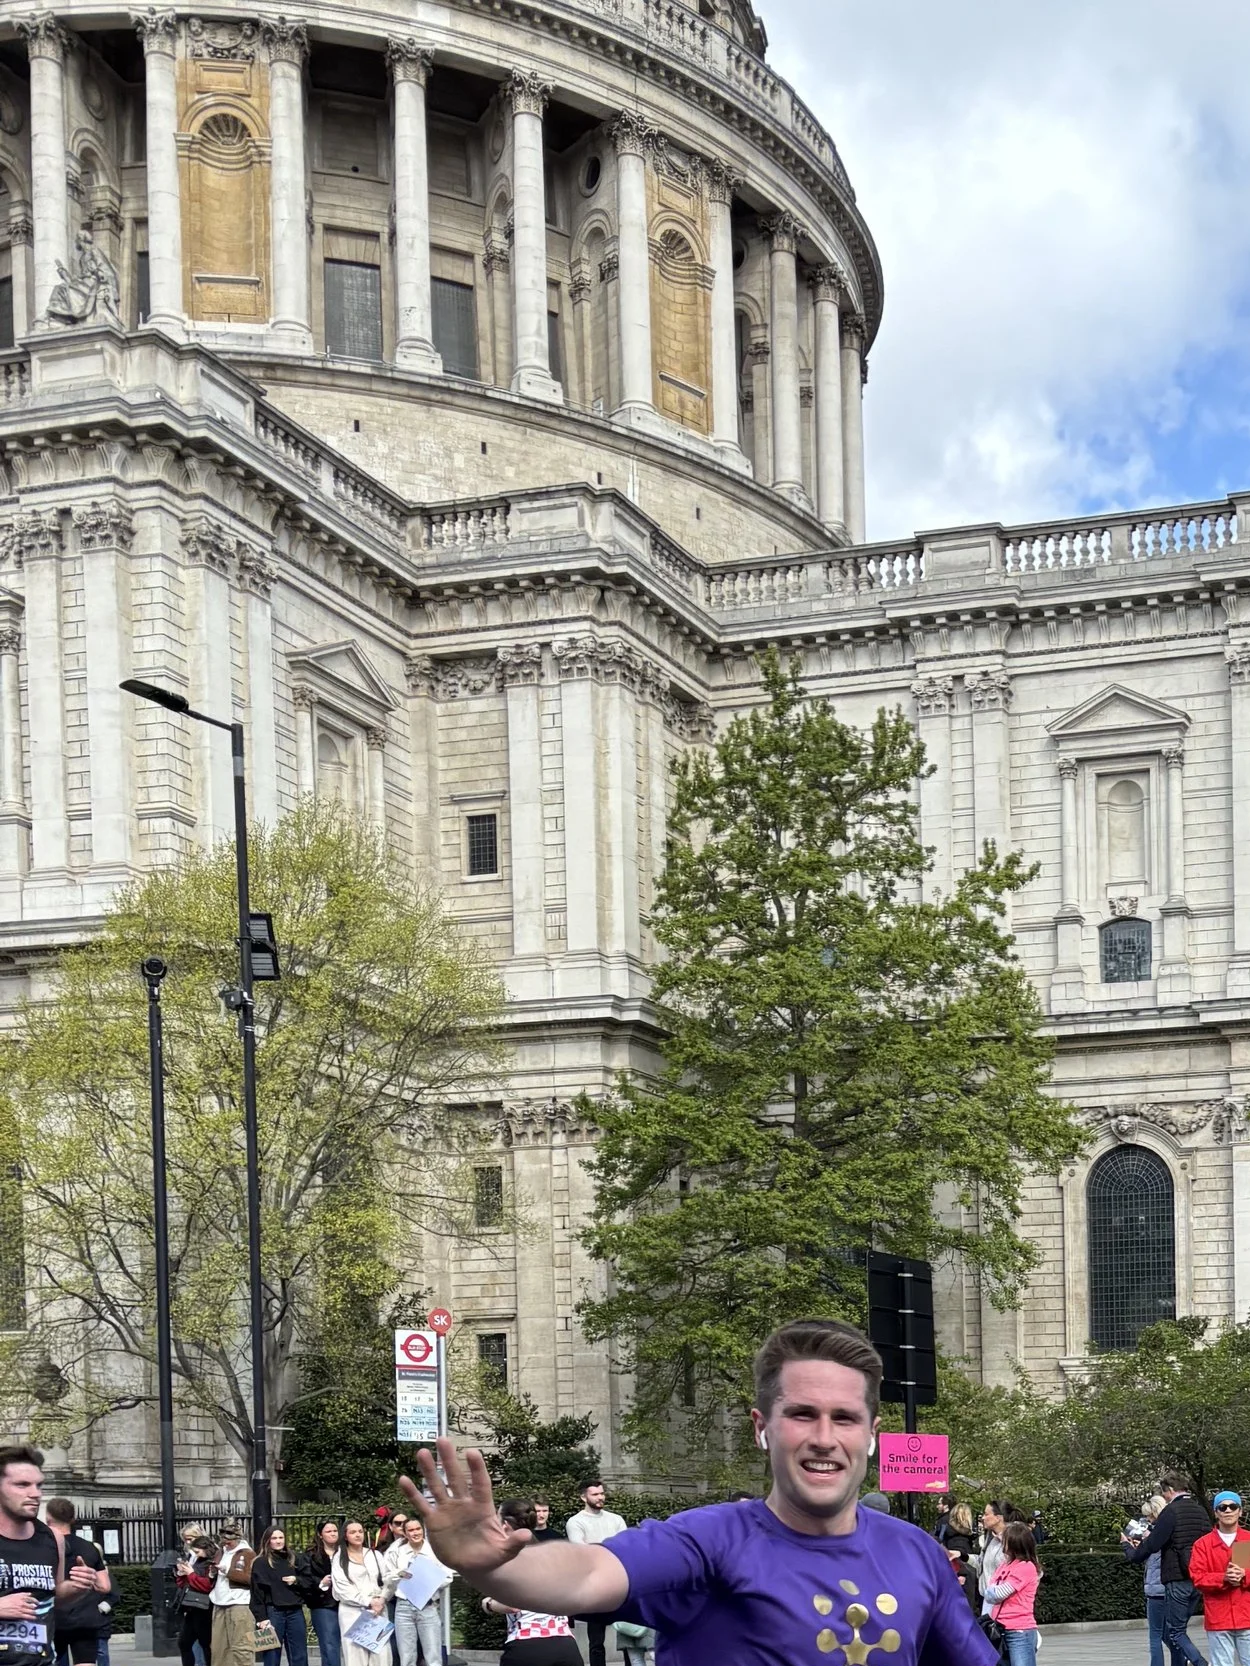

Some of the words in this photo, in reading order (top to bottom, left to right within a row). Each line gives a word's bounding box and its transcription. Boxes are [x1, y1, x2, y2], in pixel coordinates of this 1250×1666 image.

[433, 1314, 448, 1326] SK
[888, 1453, 919, 1463] Smile
[922, 1454, 938, 1464] for
[882, 1464, 900, 1474] the
[903, 1465, 947, 1475] camera!
[12, 1563, 53, 1578] PROSTATE
[13, 1576, 47, 1590] CANCER
